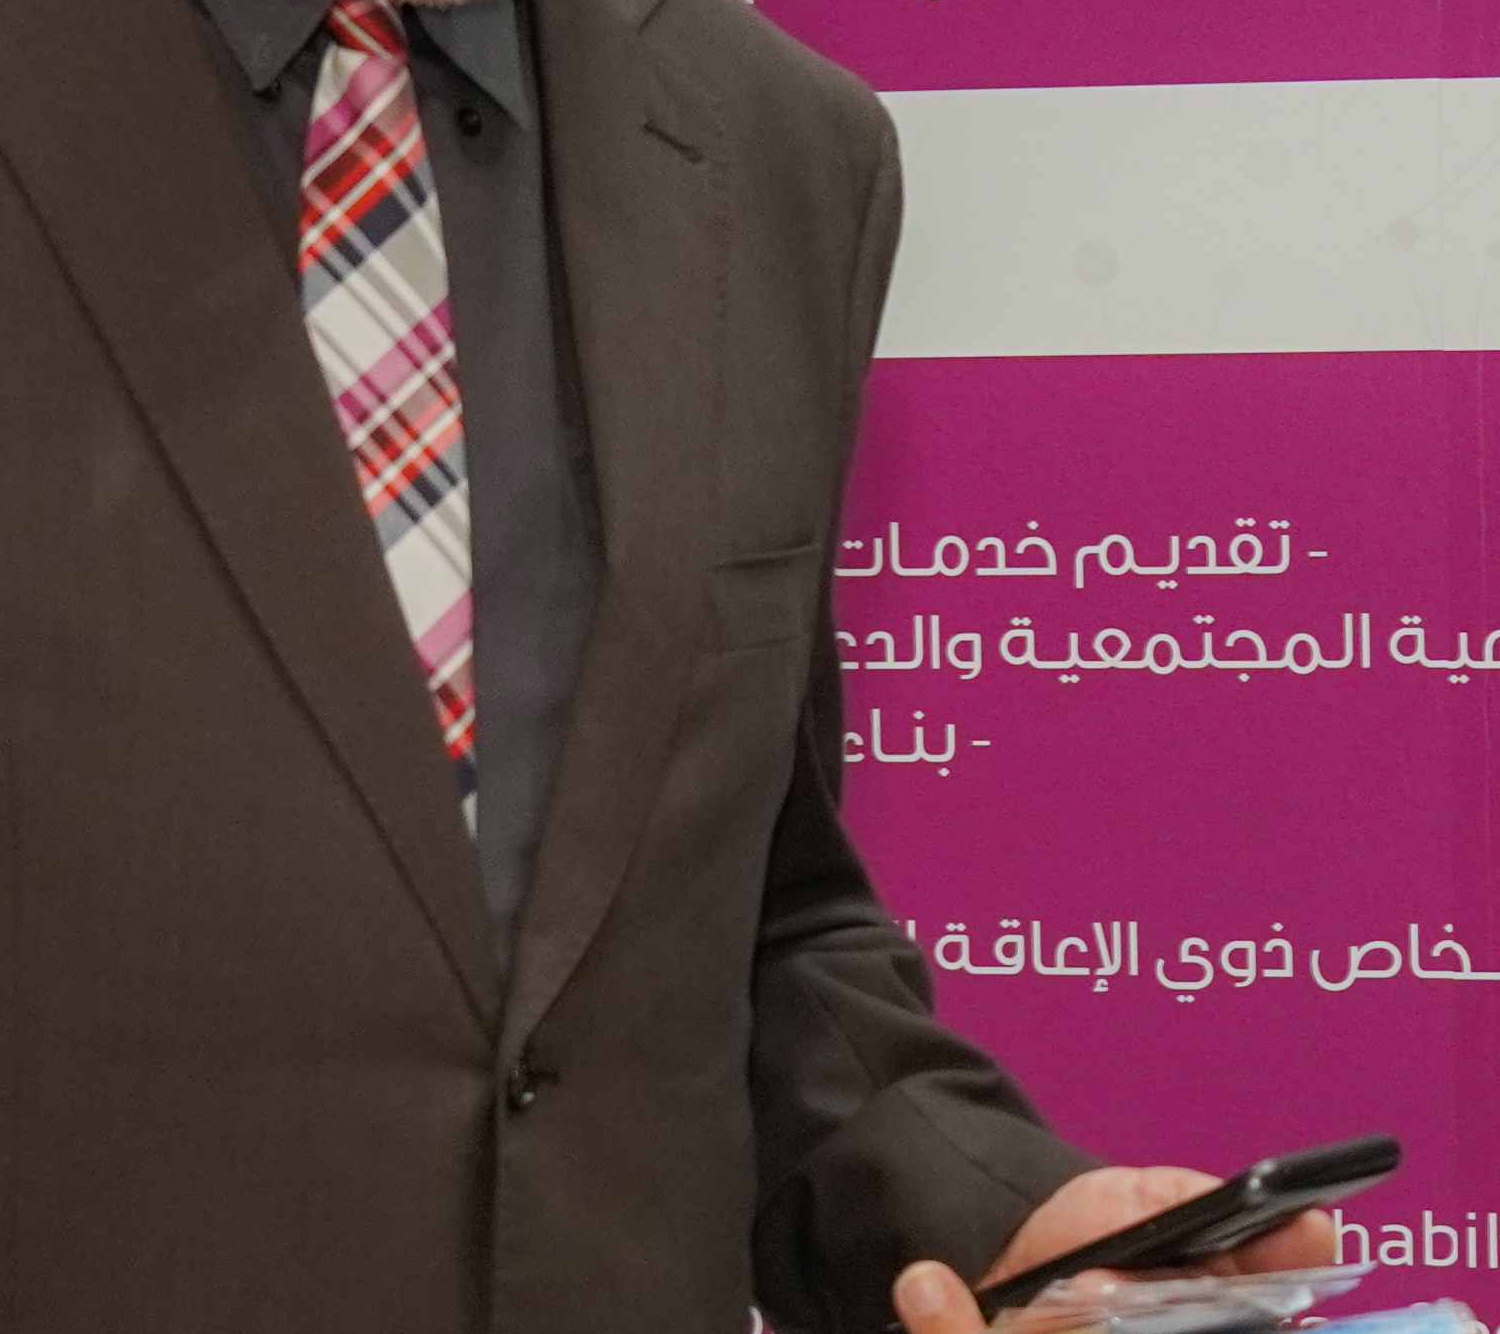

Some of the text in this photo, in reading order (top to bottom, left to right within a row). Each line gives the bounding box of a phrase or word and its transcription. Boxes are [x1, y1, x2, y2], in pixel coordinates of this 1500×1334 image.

[999, 613, 1370, 683] المجتمعية
[934, 919, 1138, 992] الإعاقة
[1156, 923, 1293, 1002] ذوي
